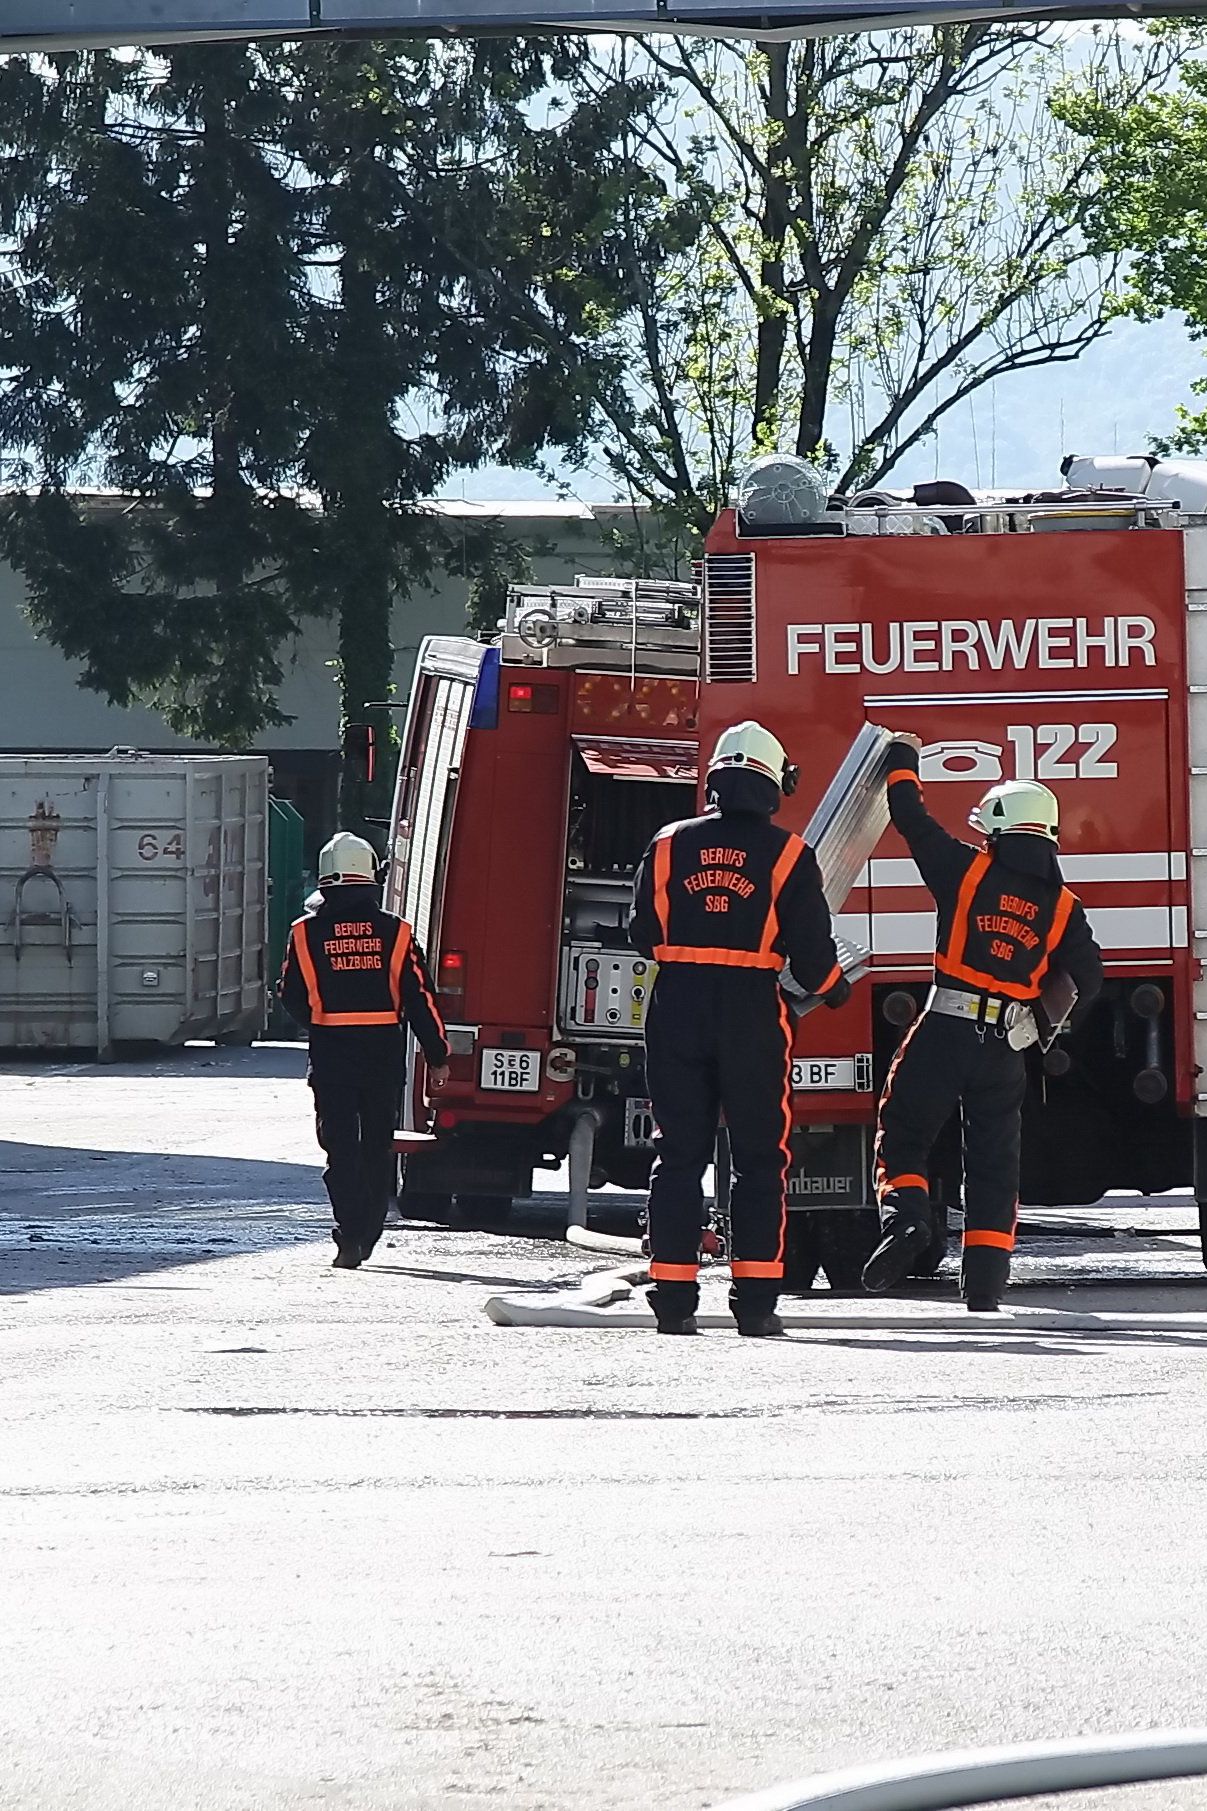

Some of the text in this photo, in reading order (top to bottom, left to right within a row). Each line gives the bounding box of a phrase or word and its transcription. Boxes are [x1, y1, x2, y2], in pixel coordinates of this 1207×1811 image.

[786, 615, 1158, 675] FEUERWEHR
[1006, 723, 1118, 780] 122
[137, 833, 186, 861] 64
[700, 847, 747, 867] BERUFS
[683, 870, 756, 899] FEUERWEHR
[705, 895, 729, 912] SBG
[1000, 894, 1039, 920] BERUFS
[334, 922, 373, 937] BERUFS
[976, 915, 1040, 950] FEUERWEHR
[323, 938, 382, 955] FEUERWEHR
[990, 939, 1015, 961] SBG
[330, 955, 382, 971] SALZBURG
[493, 1052, 505, 1069] S
[809, 1063, 838, 1084] BF
